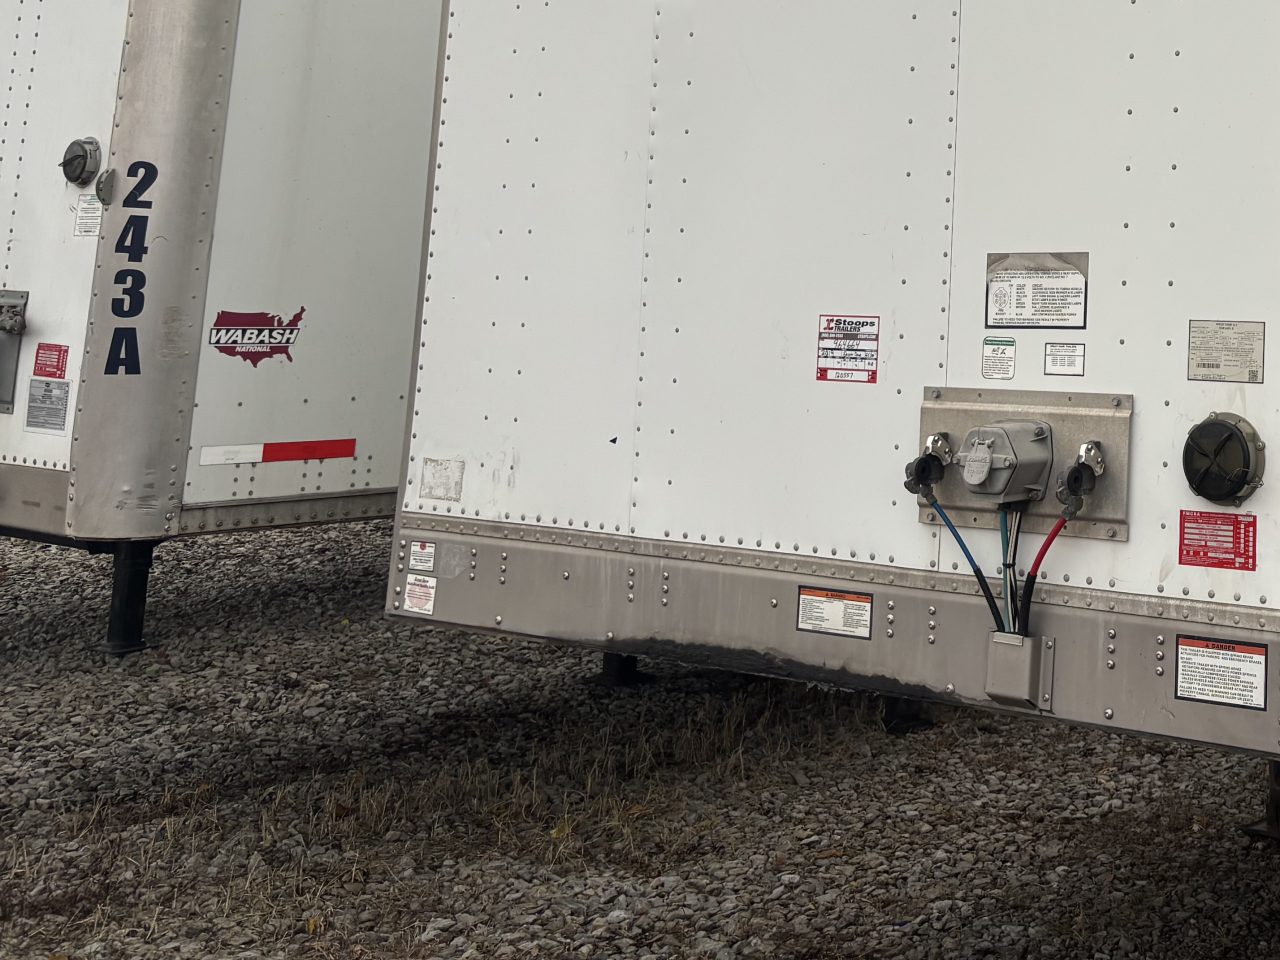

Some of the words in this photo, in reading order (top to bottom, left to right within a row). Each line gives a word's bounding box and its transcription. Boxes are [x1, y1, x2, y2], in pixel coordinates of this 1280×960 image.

[104, 160, 159, 375] 243A
[834, 319, 876, 327] Stoops
[210, 329, 299, 344] WABASH
[1211, 642, 1236, 651] DANGER
